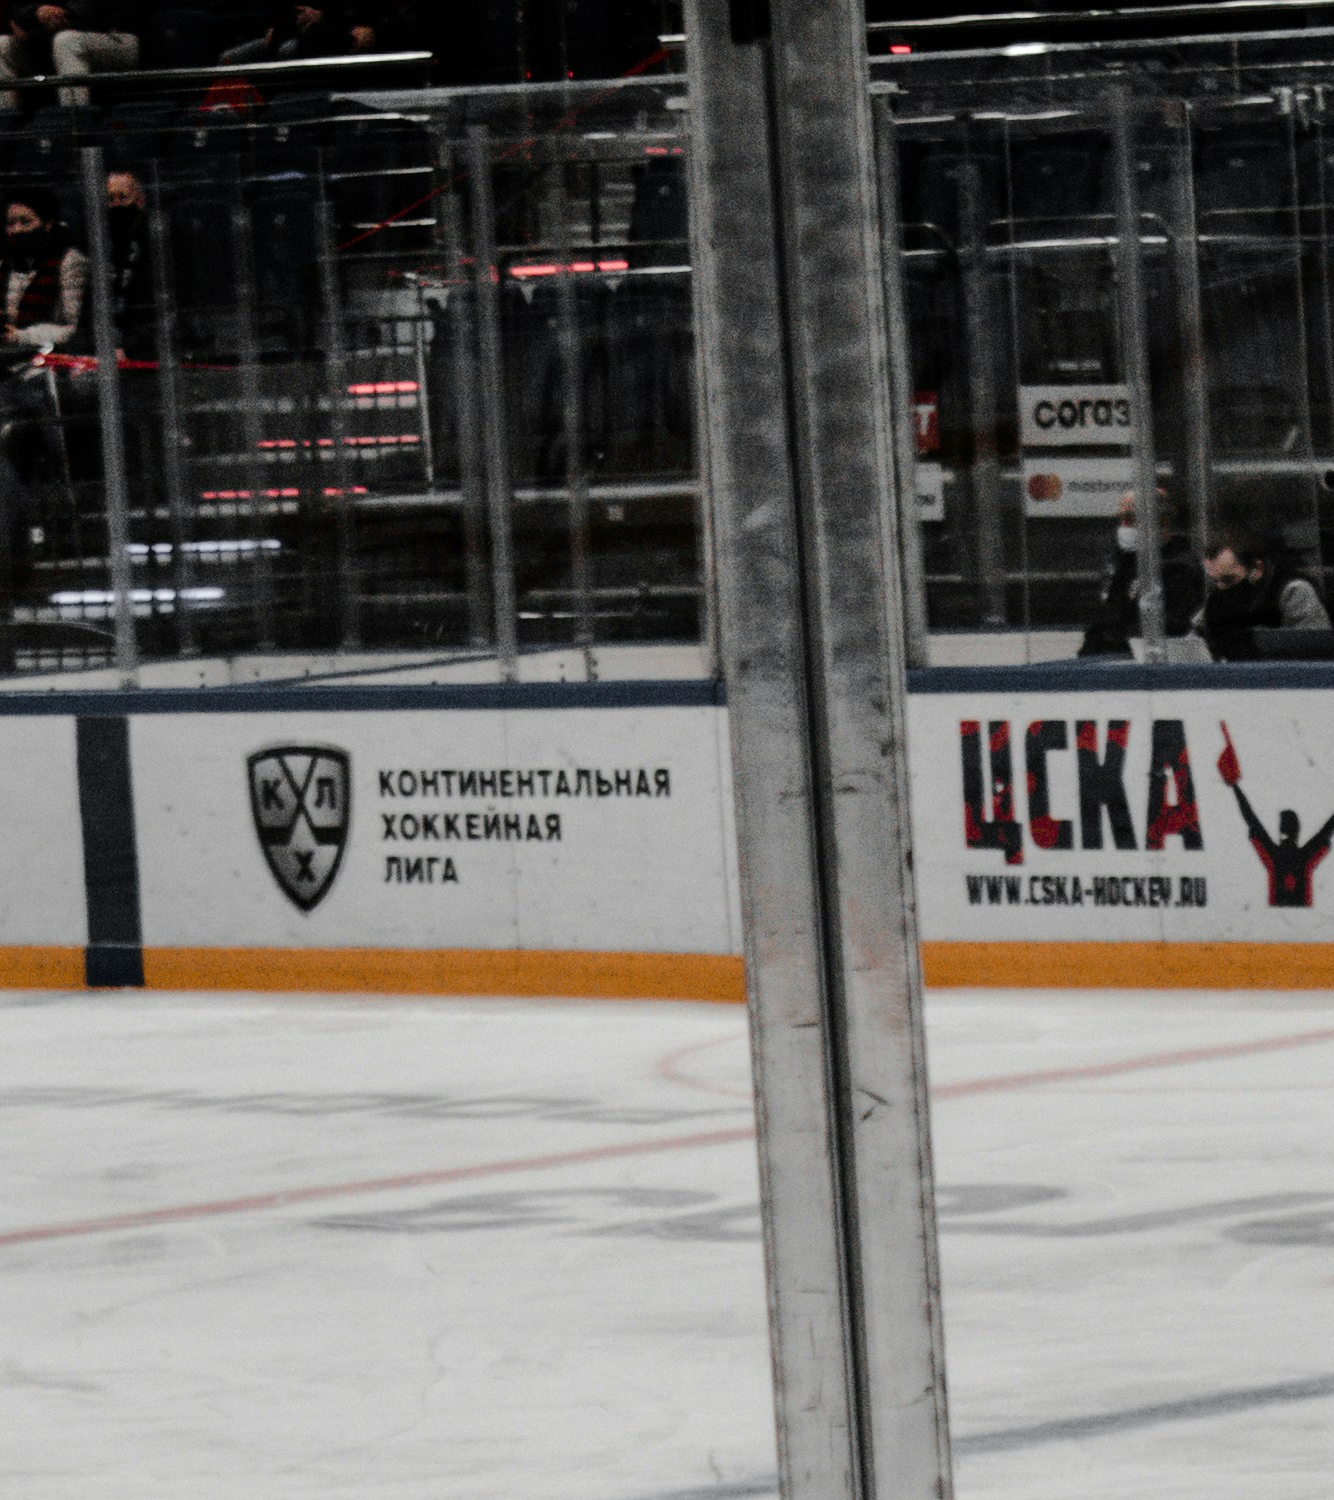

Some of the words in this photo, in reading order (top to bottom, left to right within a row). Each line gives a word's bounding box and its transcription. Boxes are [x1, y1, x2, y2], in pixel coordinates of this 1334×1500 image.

[378, 767, 670, 800] КОНТИНЕНТАЛЬНАЯ
[960, 720, 1204, 864] ЦСКА
[381, 806, 563, 842] ХОККЕЙНАЯ
[384, 856, 459, 885] ЛИГА
